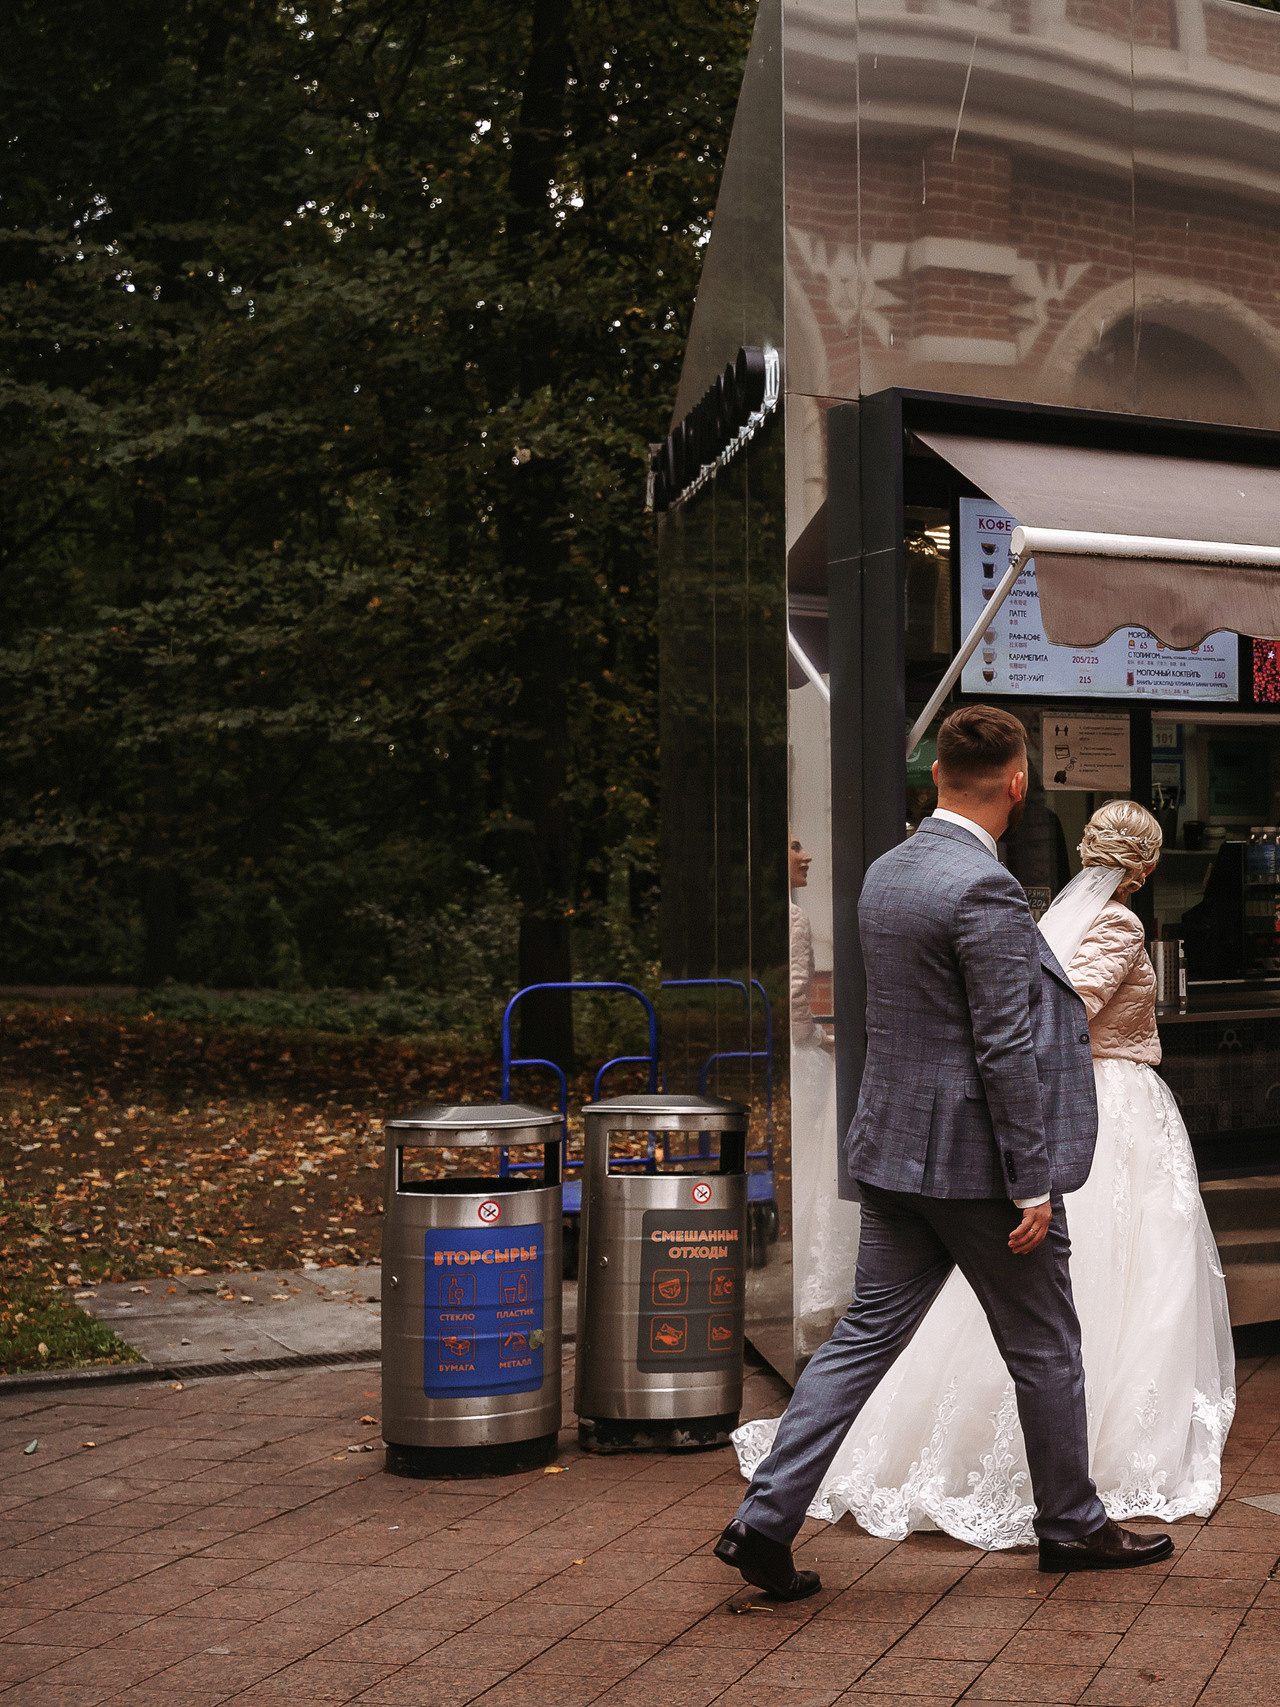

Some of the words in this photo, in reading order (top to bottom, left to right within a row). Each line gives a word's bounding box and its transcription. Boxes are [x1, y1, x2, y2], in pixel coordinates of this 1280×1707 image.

[978, 518, 1011, 531] КОФЕ
[1009, 610, 1027, 618] ЛАТТЕ
[1009, 632, 1041, 642] РАФ-КОФЕ
[1203, 645, 1215, 653] 155
[1008, 653, 1048, 662] КАРАМЕЛИТА
[1008, 672, 1044, 682] ФЛЭТ-УАЙТ
[1137, 669, 1171, 677] МОЛОЧНЫЙ
[1172, 670, 1201, 679] КОКТЕЙЛЬ
[1214, 671, 1226, 679] 160
[1079, 676, 1092, 684] 215
[1156, 733, 1173, 744] 101
[651, 1229, 738, 1242] СМЕШАННЫЕ
[434, 1246, 537, 1265] ВТОРСЫРЬЕ
[668, 1246, 728, 1260] ОТХОДЫ
[439, 1313, 475, 1321] СТЕКЛО
[496, 1308, 534, 1319] ПЛАСТИК
[439, 1364, 475, 1372] БУМАГА
[499, 1358, 532, 1369] МЕТАЛЛ
